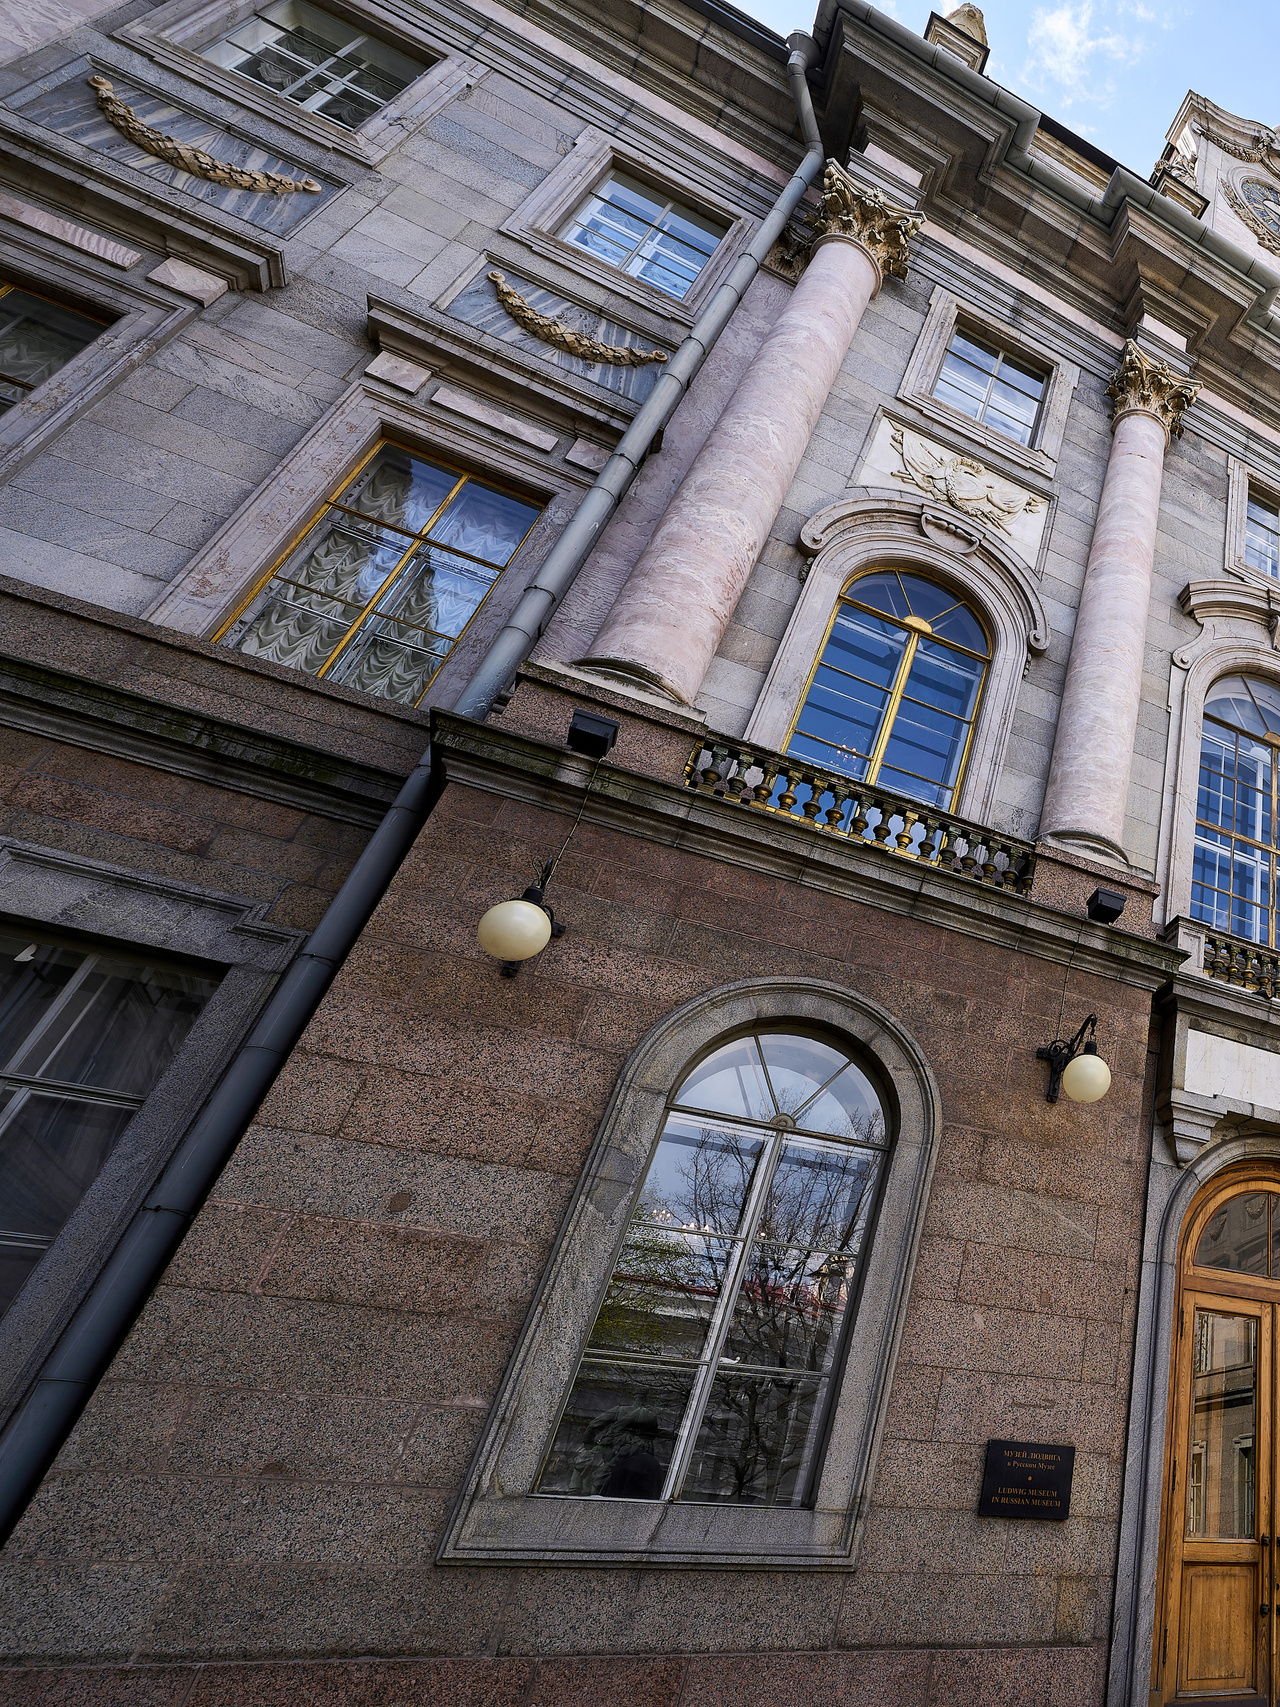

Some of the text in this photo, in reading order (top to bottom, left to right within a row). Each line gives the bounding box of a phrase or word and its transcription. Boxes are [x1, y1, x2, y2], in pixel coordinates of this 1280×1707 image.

[1003, 1450, 1061, 1462] МУЗЕЙ ЛЮДВИГА
[1012, 1460, 1037, 1469] Русском
[1038, 1462, 1056, 1471] Музее
[998, 1486, 1058, 1498] LUDWIG MUSEUM
[1000, 1497, 1031, 1506] RUSSIAN
[1031, 1499, 1061, 1508] MUSEUM
